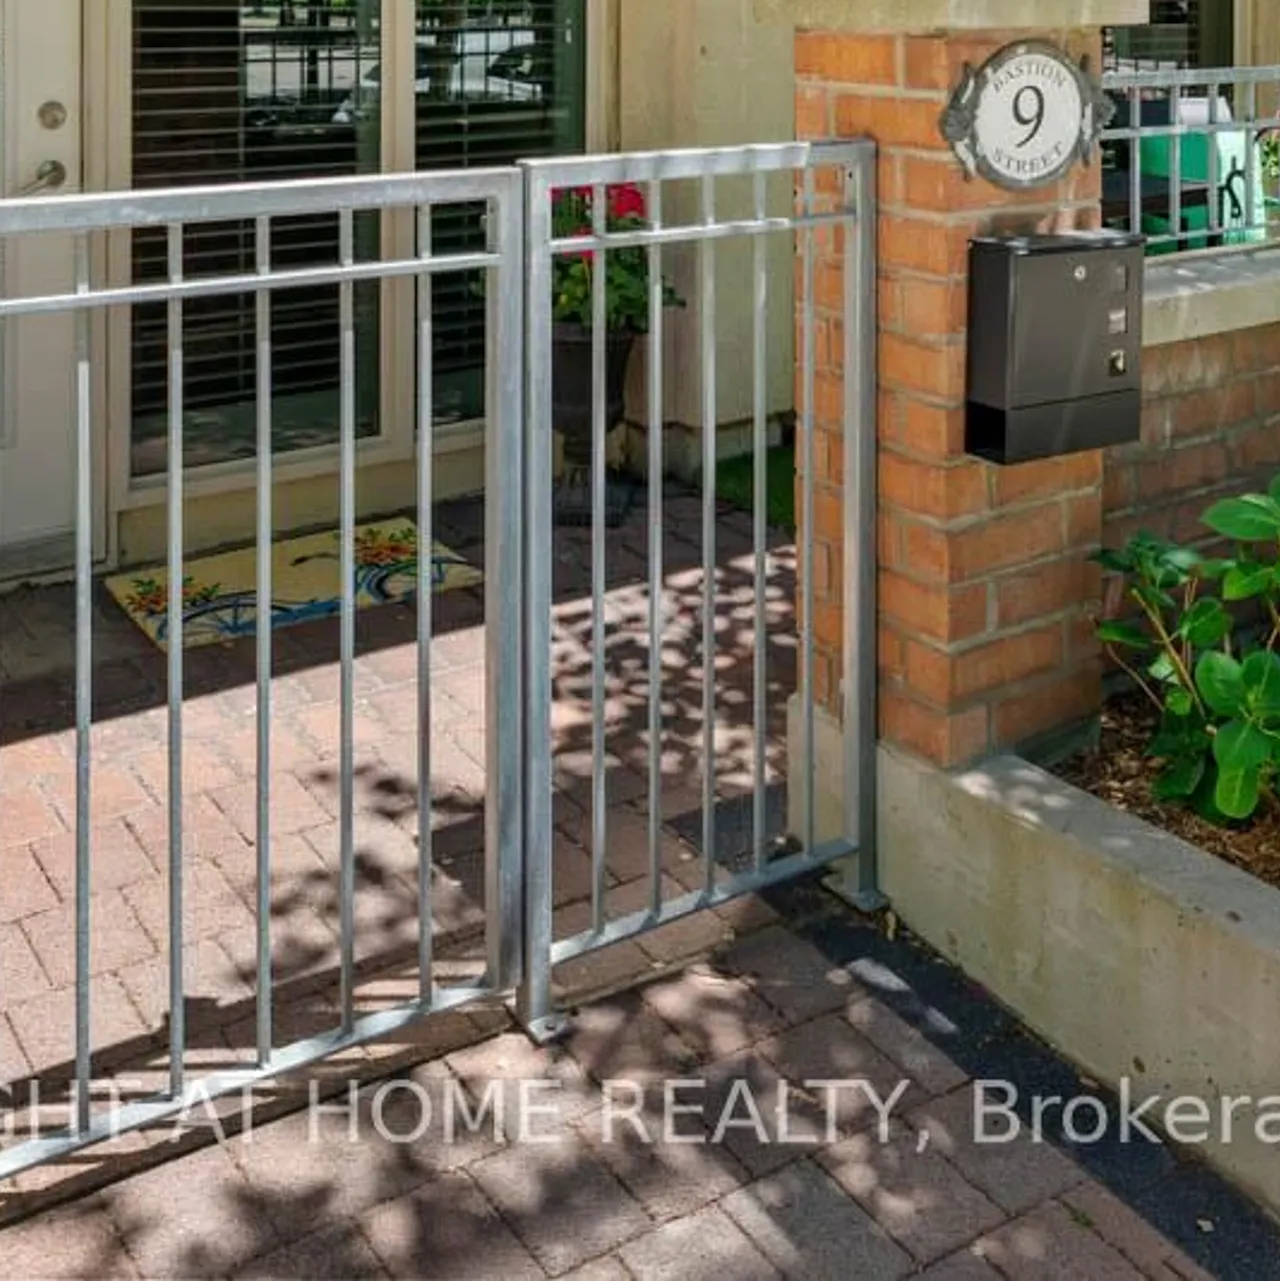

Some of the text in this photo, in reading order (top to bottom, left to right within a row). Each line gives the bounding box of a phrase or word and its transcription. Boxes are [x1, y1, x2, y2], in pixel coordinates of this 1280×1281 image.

[993, 63, 1067, 93] BASTION
[1012, 85, 1045, 149] 9
[993, 141, 1064, 173] STREET
